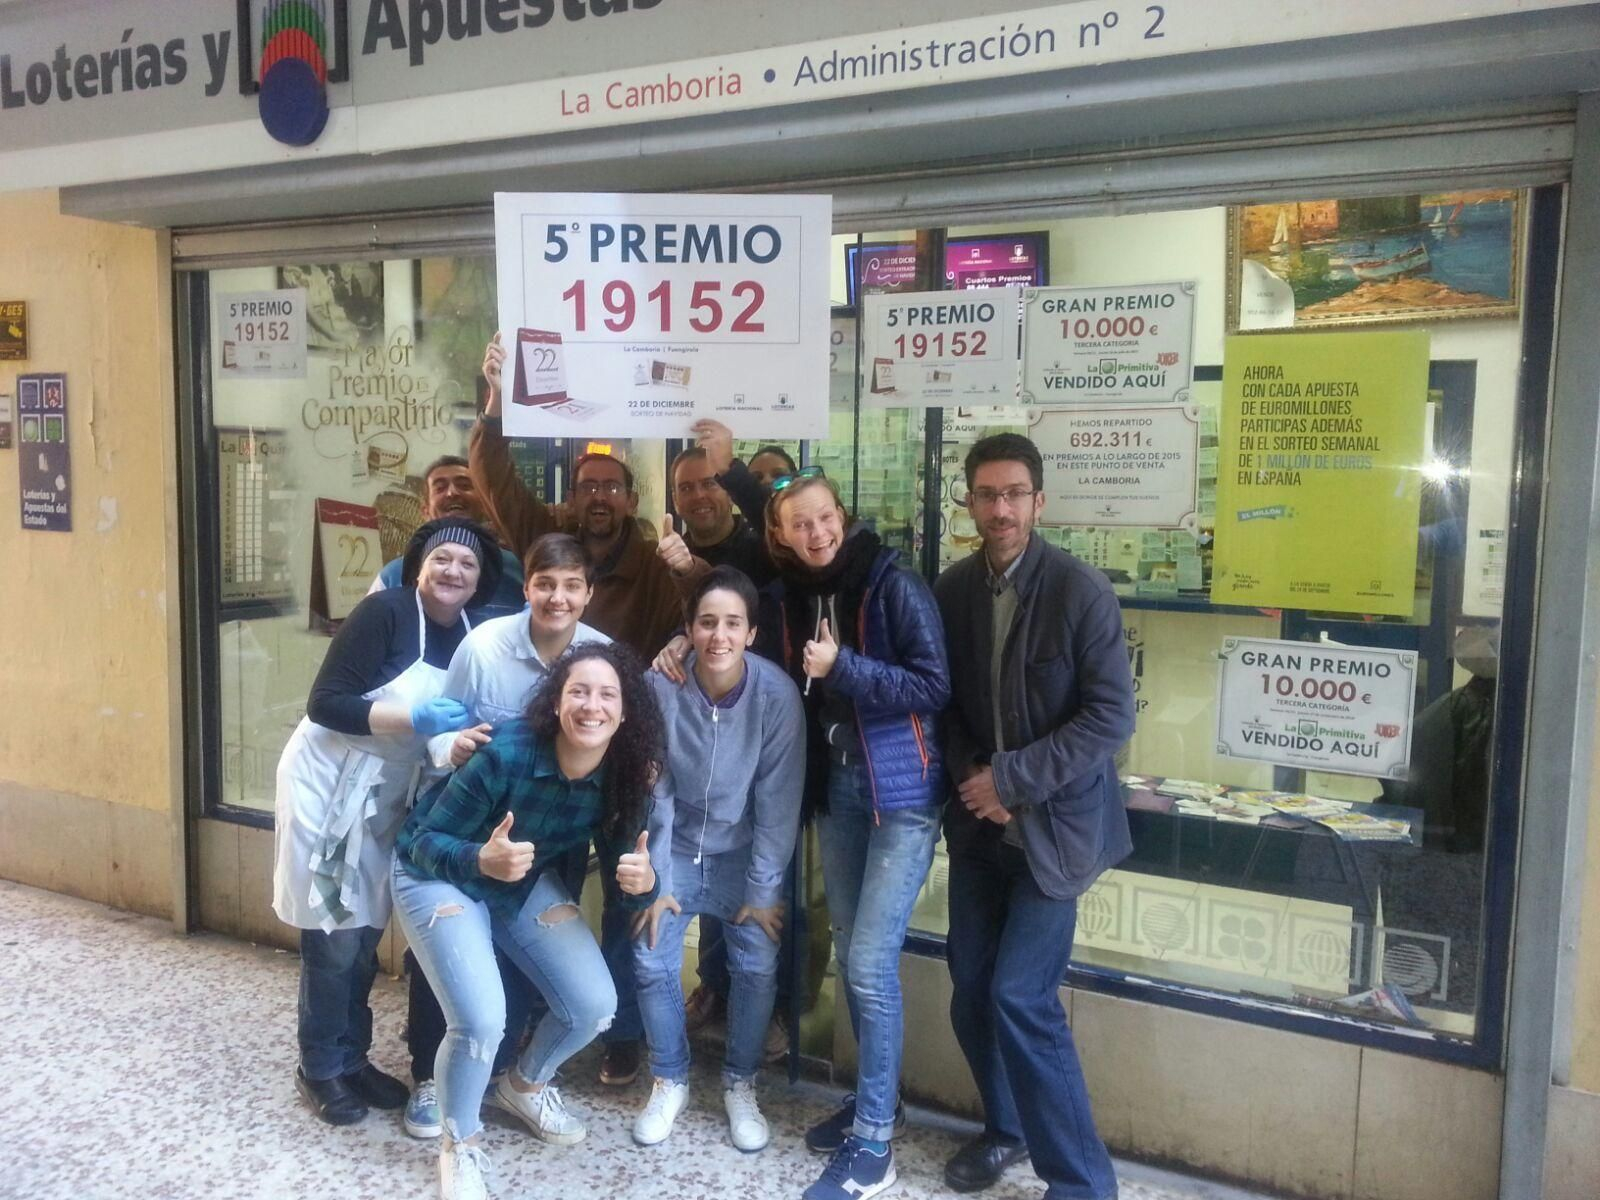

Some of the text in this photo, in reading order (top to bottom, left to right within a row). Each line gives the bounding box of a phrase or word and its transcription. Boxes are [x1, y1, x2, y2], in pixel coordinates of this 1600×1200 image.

[0, 0, 665, 108] Loterías y Apuestas
[559, 6, 1166, 116] La Camboria Administración nº 2
[590, 223, 782, 264] PREMIO
[965, 276, 997, 285] Cuartos
[998, 273, 1032, 283] Premios
[241, 301, 293, 317] PREMIO
[562, 279, 766, 333] 19152
[1042, 293, 1176, 315] GRAN PREMIO
[907, 302, 996, 326] PREMIO
[234, 321, 290, 342] 19152
[1060, 316, 1159, 340] 10.000 €
[894, 330, 988, 359] 19152
[1073, 341, 1102, 349] TERCERA
[532, 347, 559, 373] 22
[1087, 362, 1160, 373] La Primitiva
[1043, 369, 1167, 390] VENDIDO AQUÍ
[1243, 365, 1284, 380] AHORA
[328, 365, 414, 401] Premio
[1242, 381, 1360, 398] CON CADA APUESTA
[652, 400, 695, 408] DICIEMBRE
[1241, 400, 1353, 416] DE EUROMILLONES
[1070, 418, 1153, 428] HEMOS REPARTIDO
[1240, 418, 1307, 433] PARTICIPAS
[220, 440, 237, 454] La
[1069, 431, 1142, 448] 692.311
[1239, 435, 1381, 451] EN EL SORTEO SEMANAL
[1042, 452, 1181, 461] EN PREMIOS A LO LARGO DE 2015
[1238, 453, 1253, 468] DE
[1313, 455, 1330, 469] DE
[1332, 454, 1373, 470] EUROS
[1057, 461, 1165, 470] EN ESTE PUNTO DE VENTA
[1078, 476, 1141, 485] LA CAMBORIA
[1237, 469, 1302, 486] EN ESPAÑA
[24, 502, 67, 514] Apuestas del
[24, 514, 48, 526] Estado
[1241, 651, 1391, 678] GRAN PREMIO
[1260, 673, 1373, 705] 10.000 €
[1275, 698, 1307, 708] TERCERA
[1284, 723, 1297, 732] La
[1318, 727, 1366, 741] Primitiva
[1241, 729, 1324, 752] VENDIDO
[1329, 740, 1380, 759] AQUÍ
